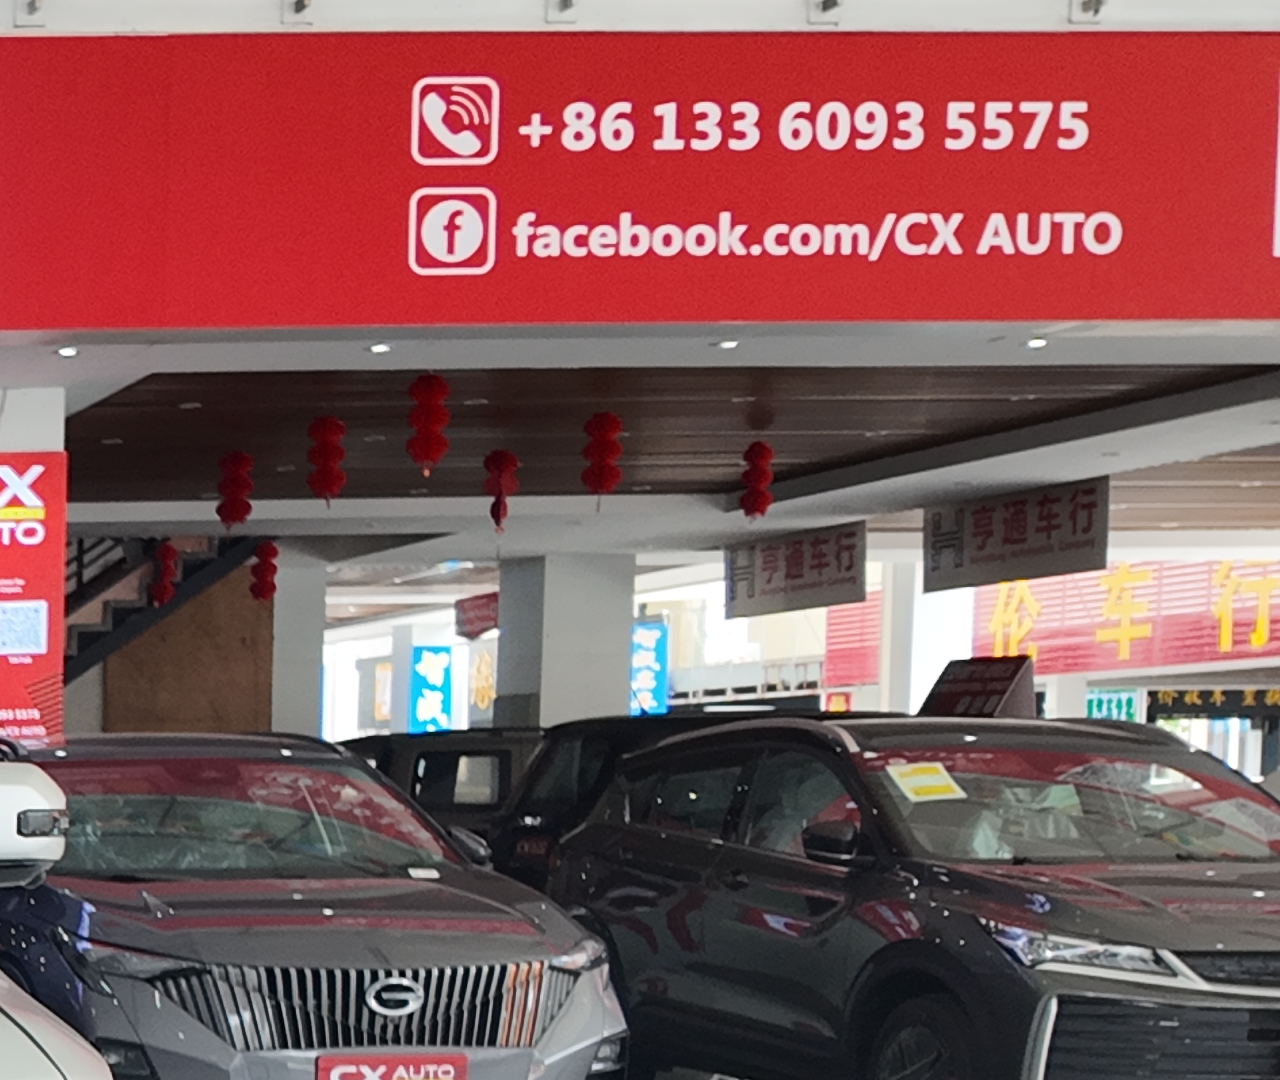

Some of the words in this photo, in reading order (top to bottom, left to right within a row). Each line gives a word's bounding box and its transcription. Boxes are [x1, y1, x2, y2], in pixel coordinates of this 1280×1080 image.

[517, 101, 635, 152] +86
[652, 101, 761, 151] 133
[778, 101, 925, 151] 6093
[943, 101, 1090, 151] 5575
[512, 210, 963, 262] facebook.com/CX
[977, 212, 1123, 256] AUTO
[392, 1063, 456, 1080] AUTO
